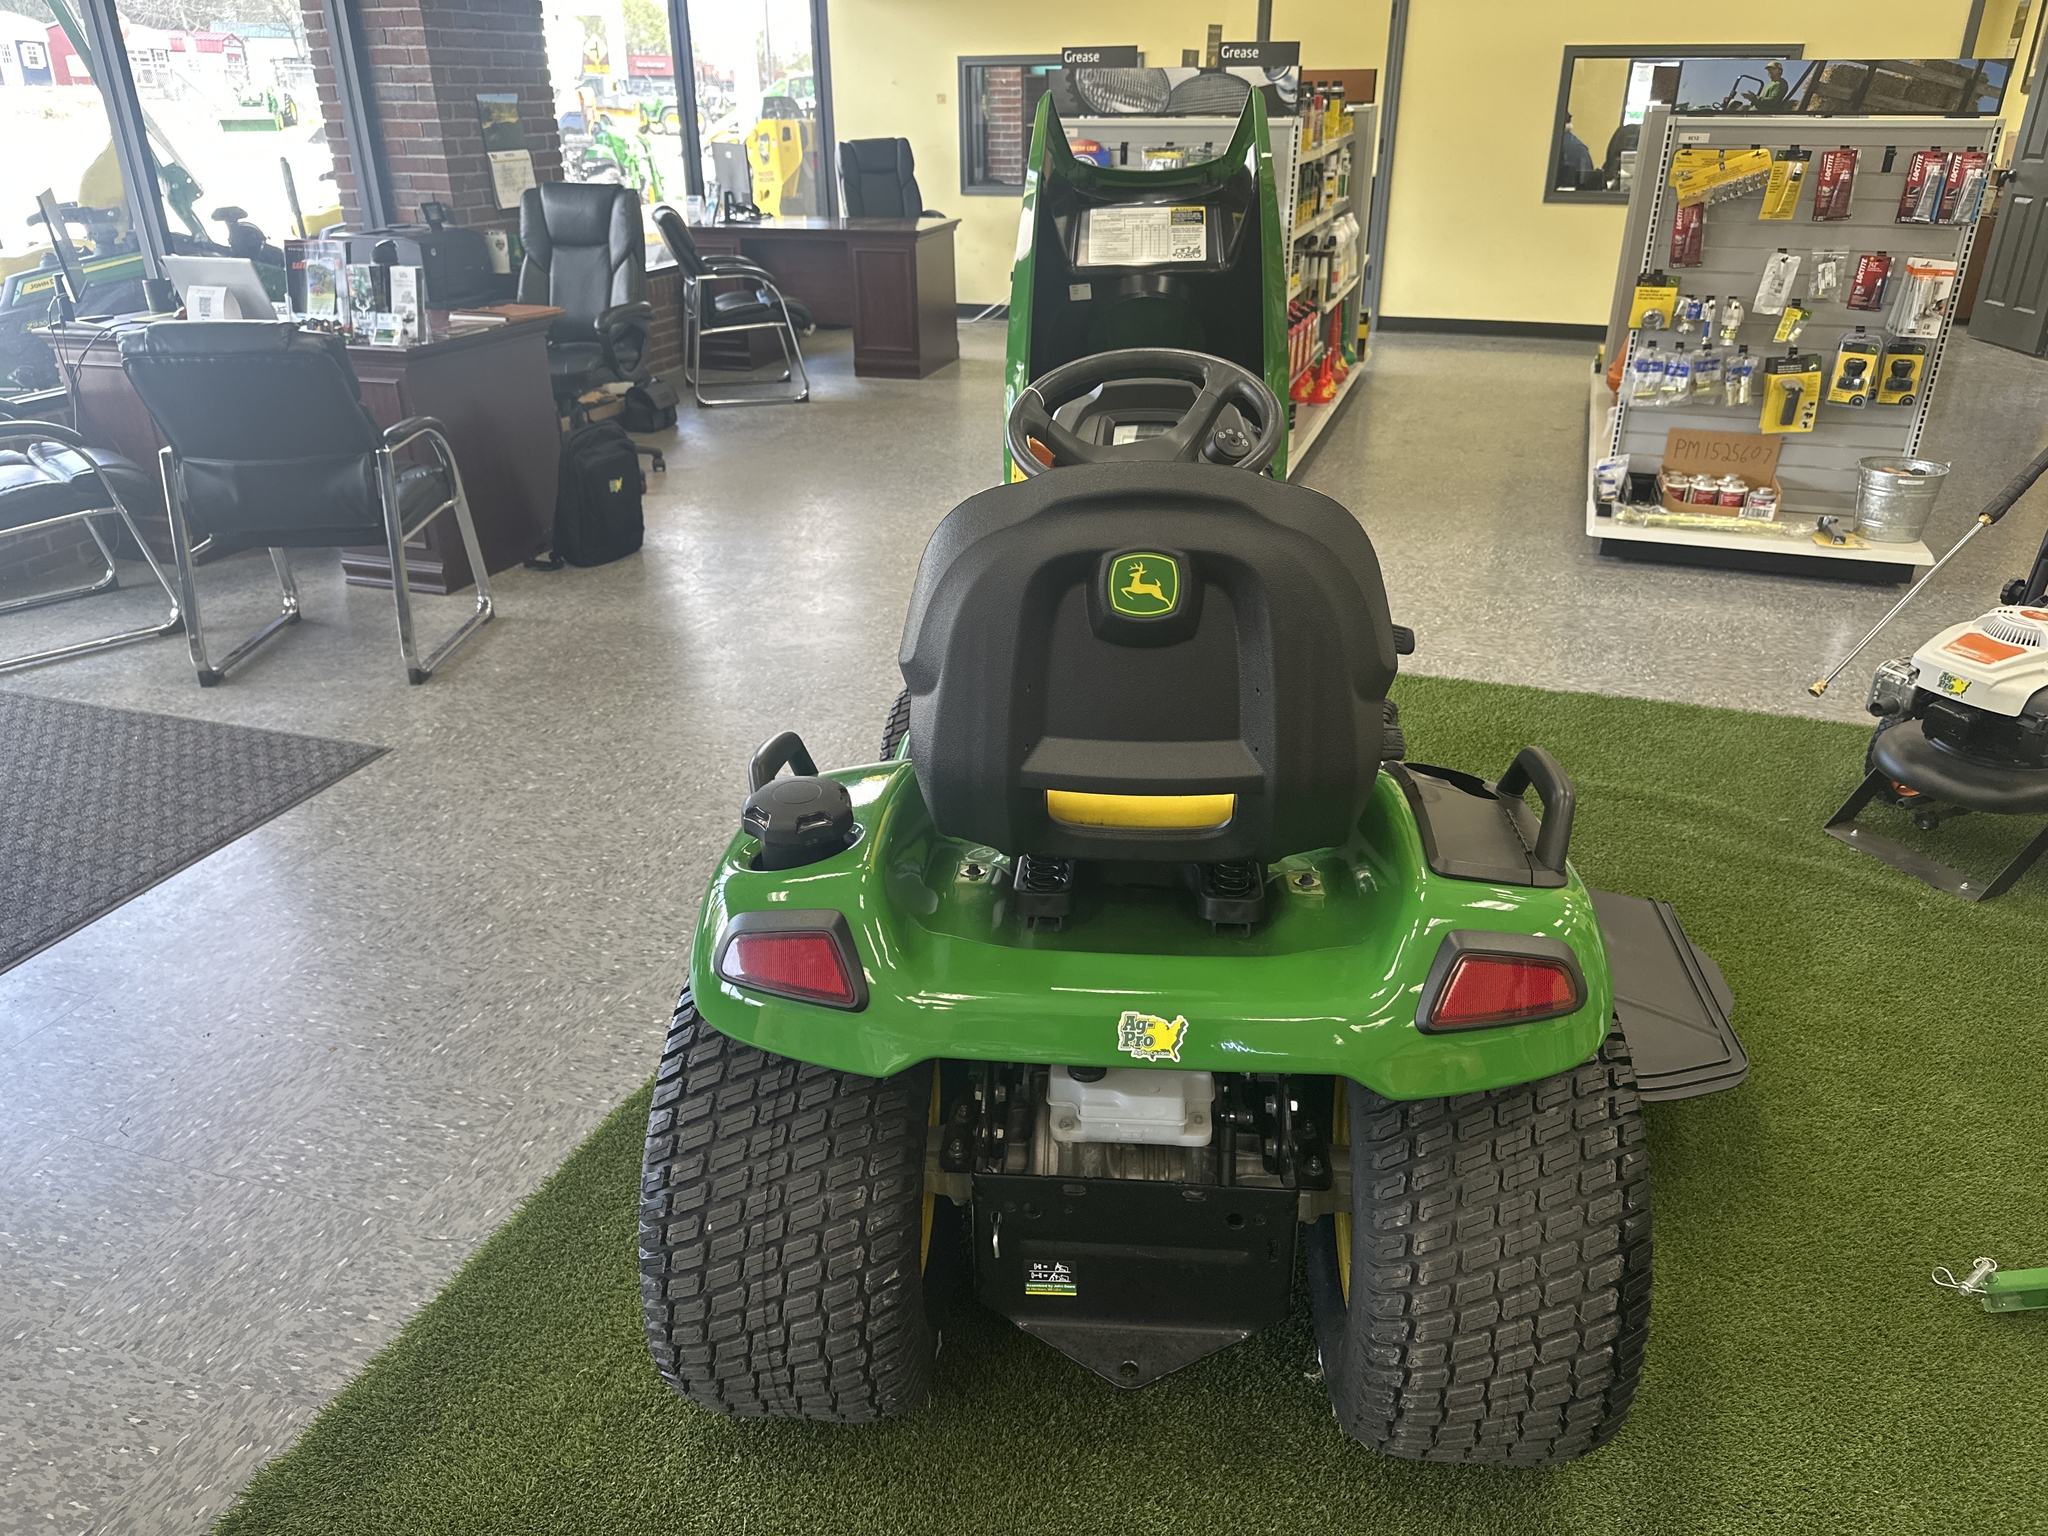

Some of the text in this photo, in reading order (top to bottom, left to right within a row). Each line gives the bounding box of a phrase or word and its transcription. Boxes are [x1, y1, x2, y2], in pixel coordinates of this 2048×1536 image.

[1064, 50, 1100, 63] Grease
[1220, 45, 1259, 59] Grease
[1824, 154, 1835, 181] LOCTITE
[1912, 154, 1924, 182] LOCTITE
[1949, 154, 1963, 183] LOCTITE
[1676, 208, 1684, 230] LOCTIT
[1855, 257, 1868, 284] LOCTITE
[1123, 1015, 1154, 1034] Ag-
[1122, 1037, 1154, 1052] Pro
